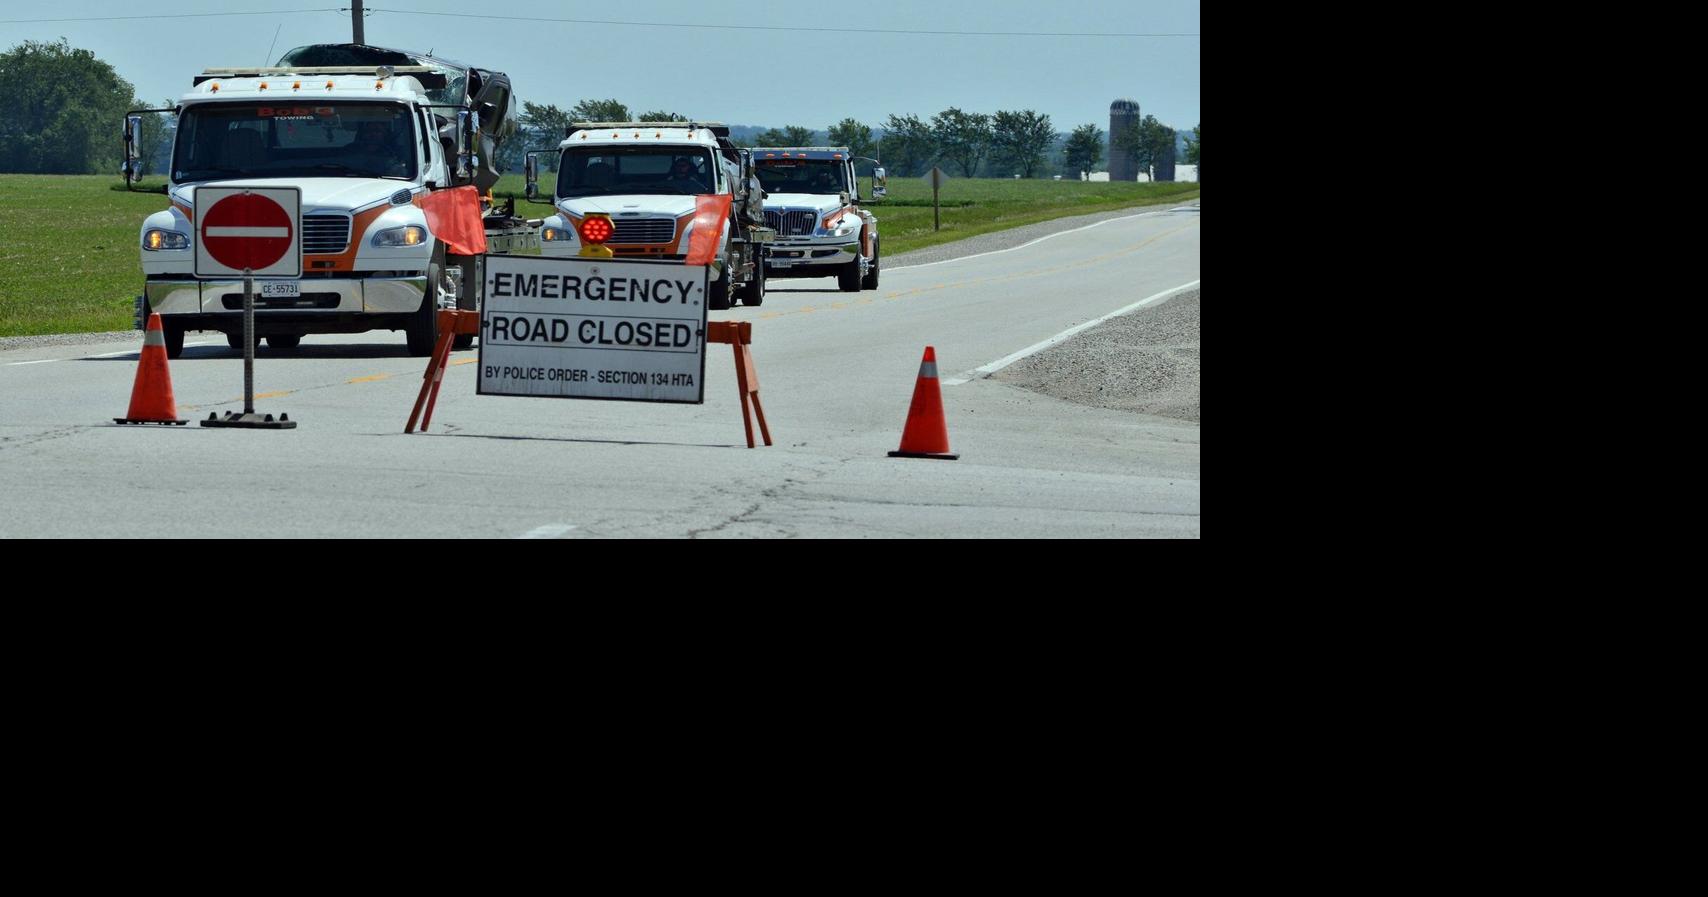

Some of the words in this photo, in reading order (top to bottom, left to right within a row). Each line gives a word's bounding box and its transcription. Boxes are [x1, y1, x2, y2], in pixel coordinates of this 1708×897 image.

[494, 272, 694, 304] EMERGENCY
[492, 316, 569, 343] ROAD
[578, 319, 691, 347] CLOSED
[485, 365, 501, 379] BY
[503, 366, 545, 381] POLICE
[547, 368, 588, 382] ORDER
[597, 370, 647, 385] SECTION
[650, 372, 669, 386] 134
[671, 373, 694, 387] HTA
